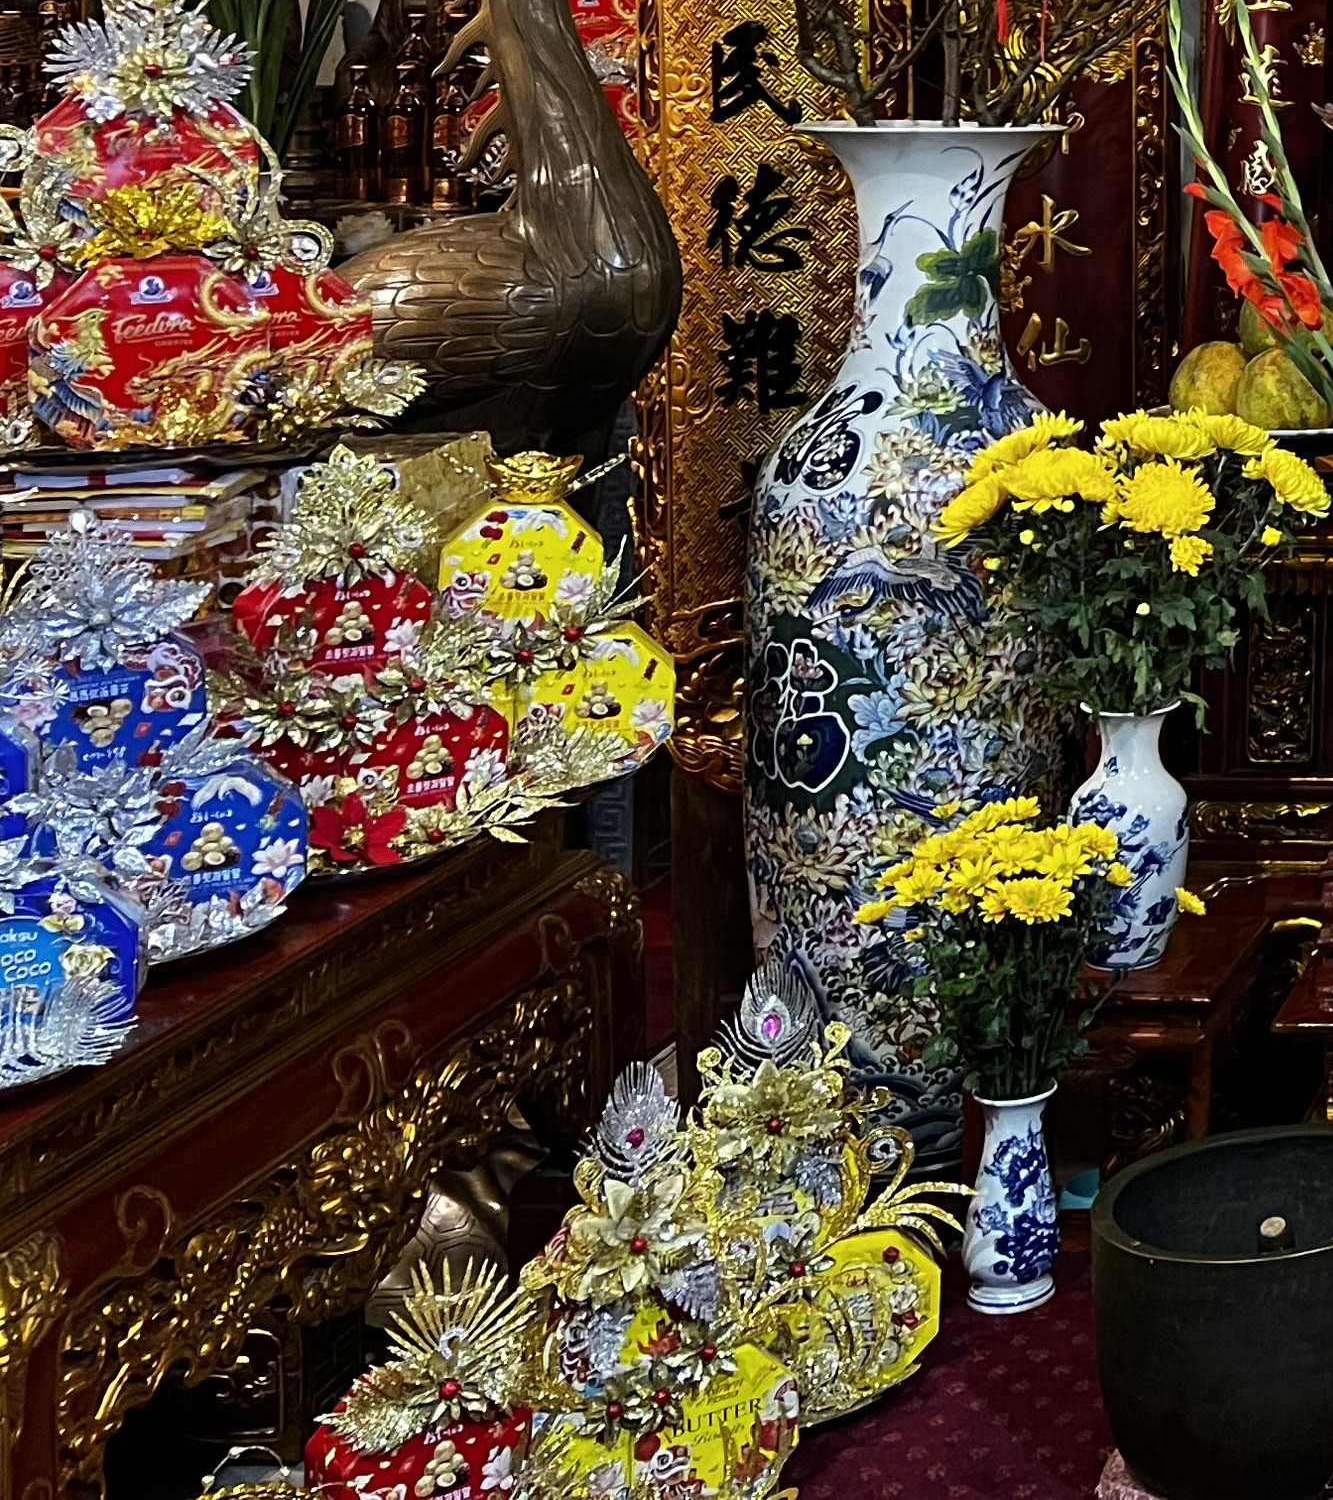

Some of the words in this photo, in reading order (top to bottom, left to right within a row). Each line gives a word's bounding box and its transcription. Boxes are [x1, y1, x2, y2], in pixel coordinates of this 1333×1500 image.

[0, 948, 37, 967] oco
[4, 961, 52, 983] Coco
[672, 1398, 762, 1438] BUTTER
